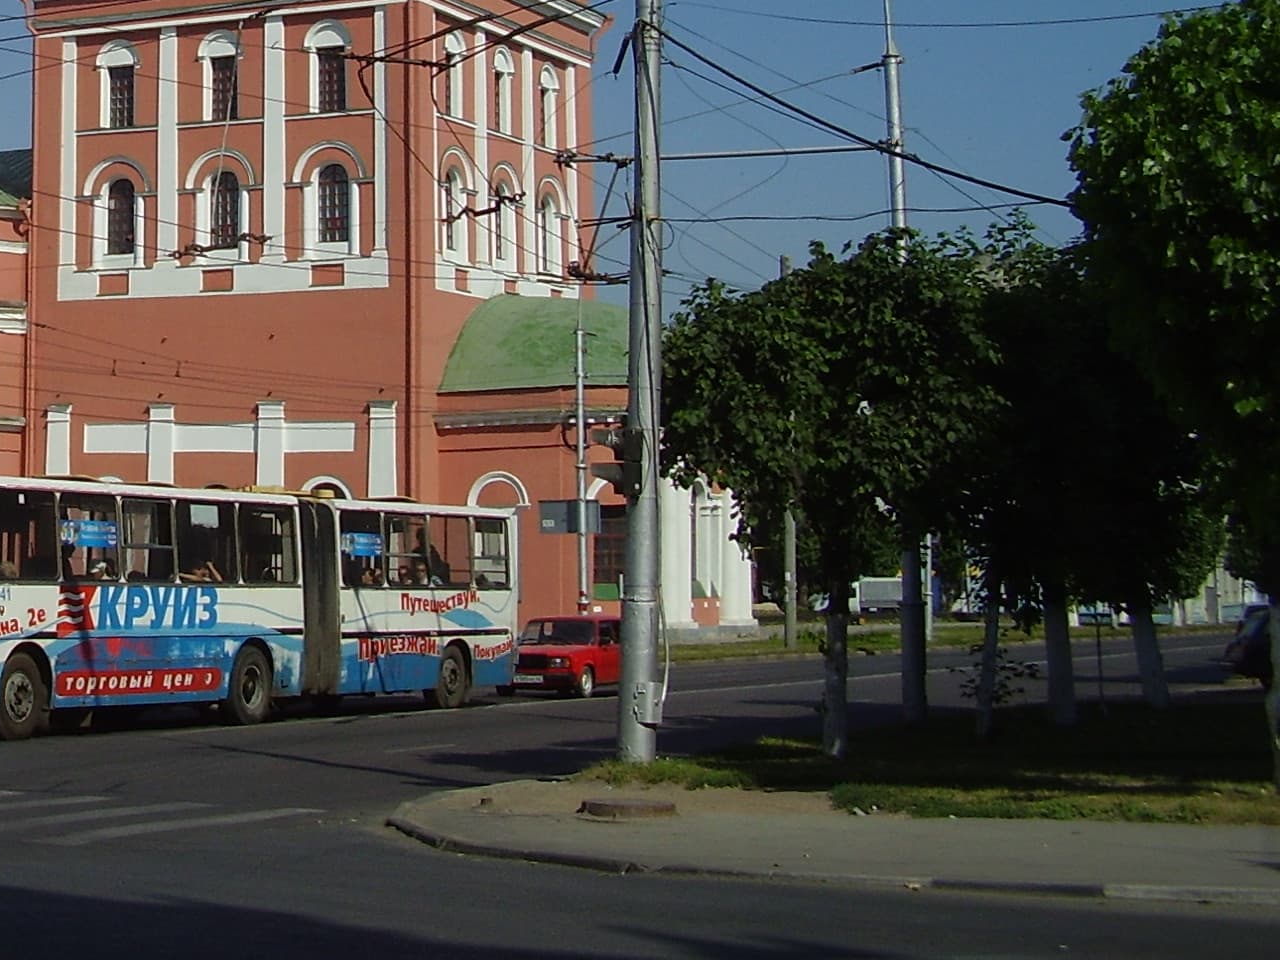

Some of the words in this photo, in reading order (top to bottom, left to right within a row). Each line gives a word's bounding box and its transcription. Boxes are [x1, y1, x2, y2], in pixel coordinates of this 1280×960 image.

[27, 607, 47, 627] 2е
[98, 586, 218, 630] КРУИЗ
[65, 671, 153, 694] торговый
